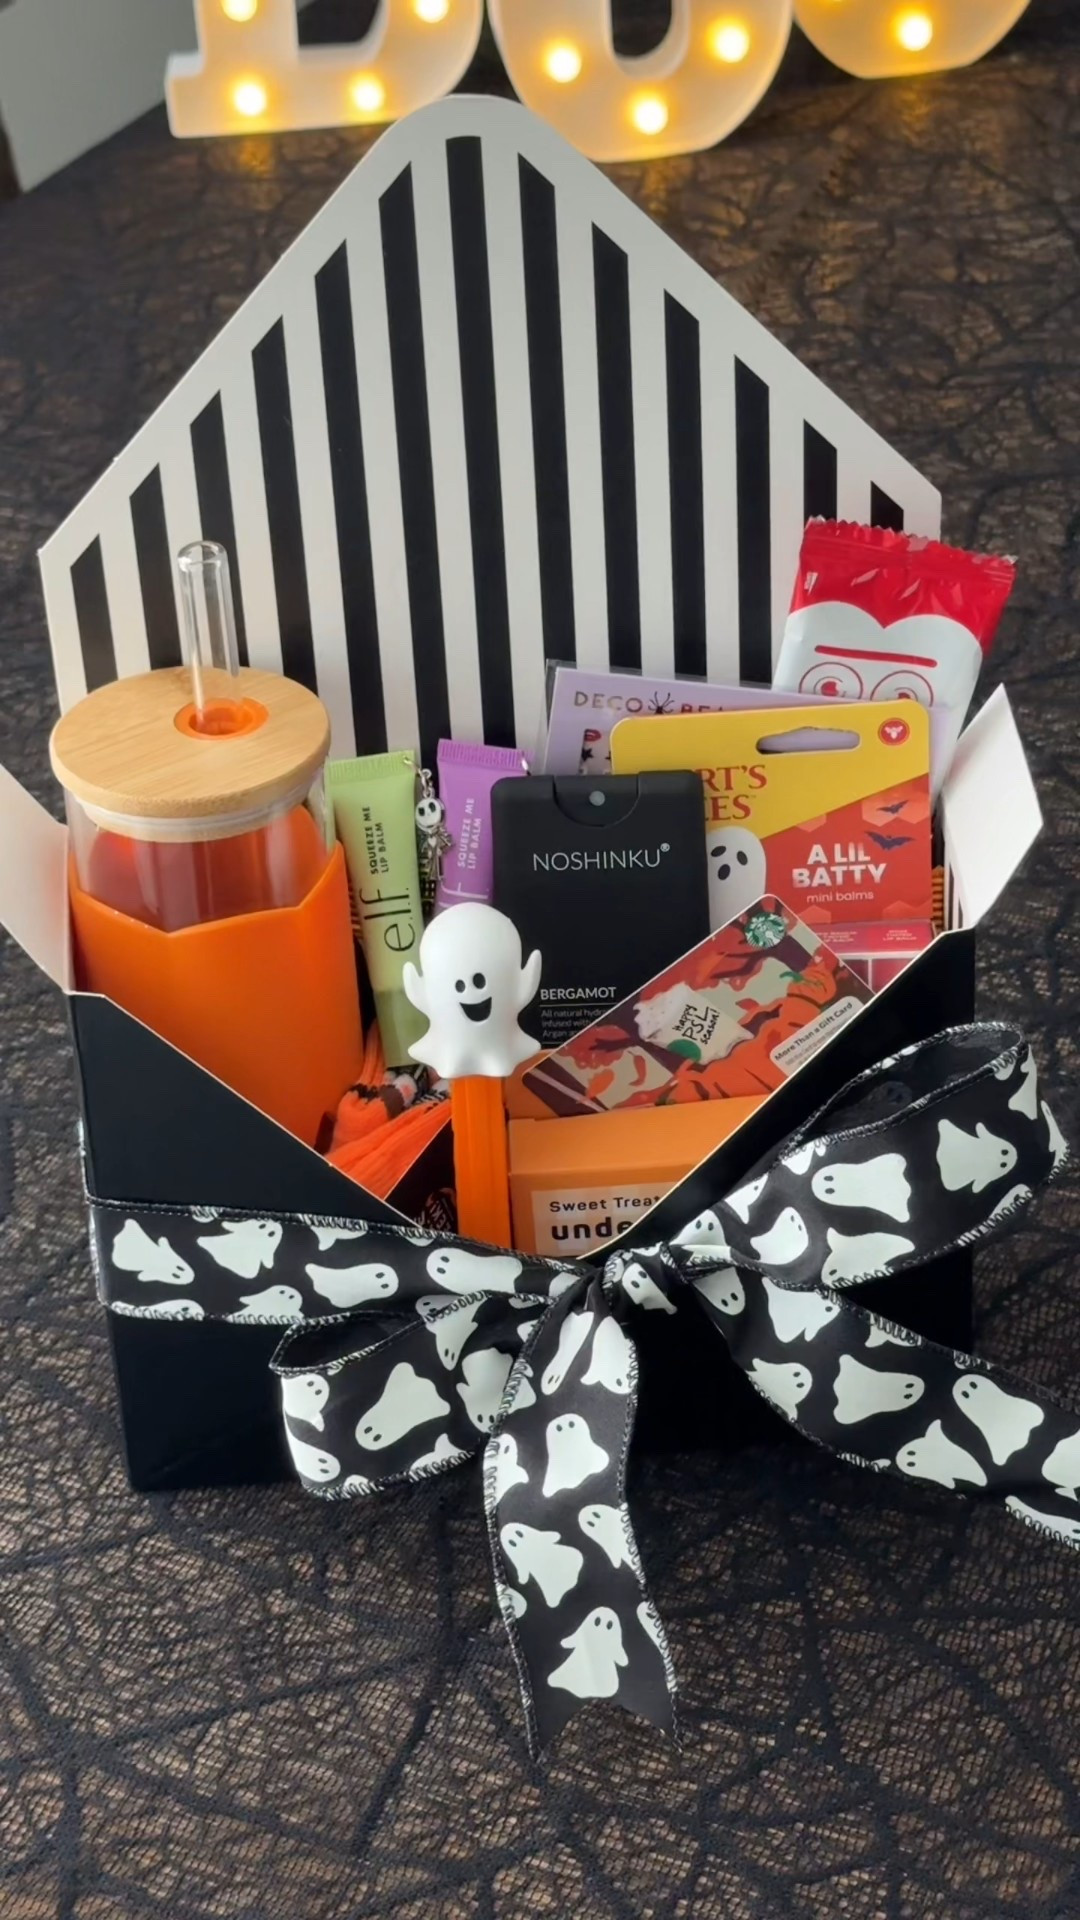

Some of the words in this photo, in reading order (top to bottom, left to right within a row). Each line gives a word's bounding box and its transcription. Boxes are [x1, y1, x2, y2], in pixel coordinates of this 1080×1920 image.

[573, 691, 644, 713] DECO
[362, 806, 371, 821] ME
[703, 794, 752, 821] ES
[375, 822, 388, 854] BALM
[457, 818, 472, 867] SQUEEZE
[465, 798, 475, 815] ME
[470, 818, 482, 849] BALM
[364, 826, 379, 875] SQUEEZE
[467, 853, 477, 870] LIP
[807, 844, 828, 865] A
[834, 842, 871, 863] LIL
[378, 857, 389, 873] LIP
[792, 863, 887, 888] BATTY
[806, 891, 833, 903] mini
[835, 890, 874, 902] balms
[540, 987, 617, 1000] BERGAMOT
[681, 1006, 710, 1041] PSL
[774, 1045, 796, 1060] More
[795, 1031, 814, 1046] Than
[819, 1016, 836, 1029] Gift
[834, 1002, 853, 1018] Card
[549, 1200, 607, 1213] Sweet
